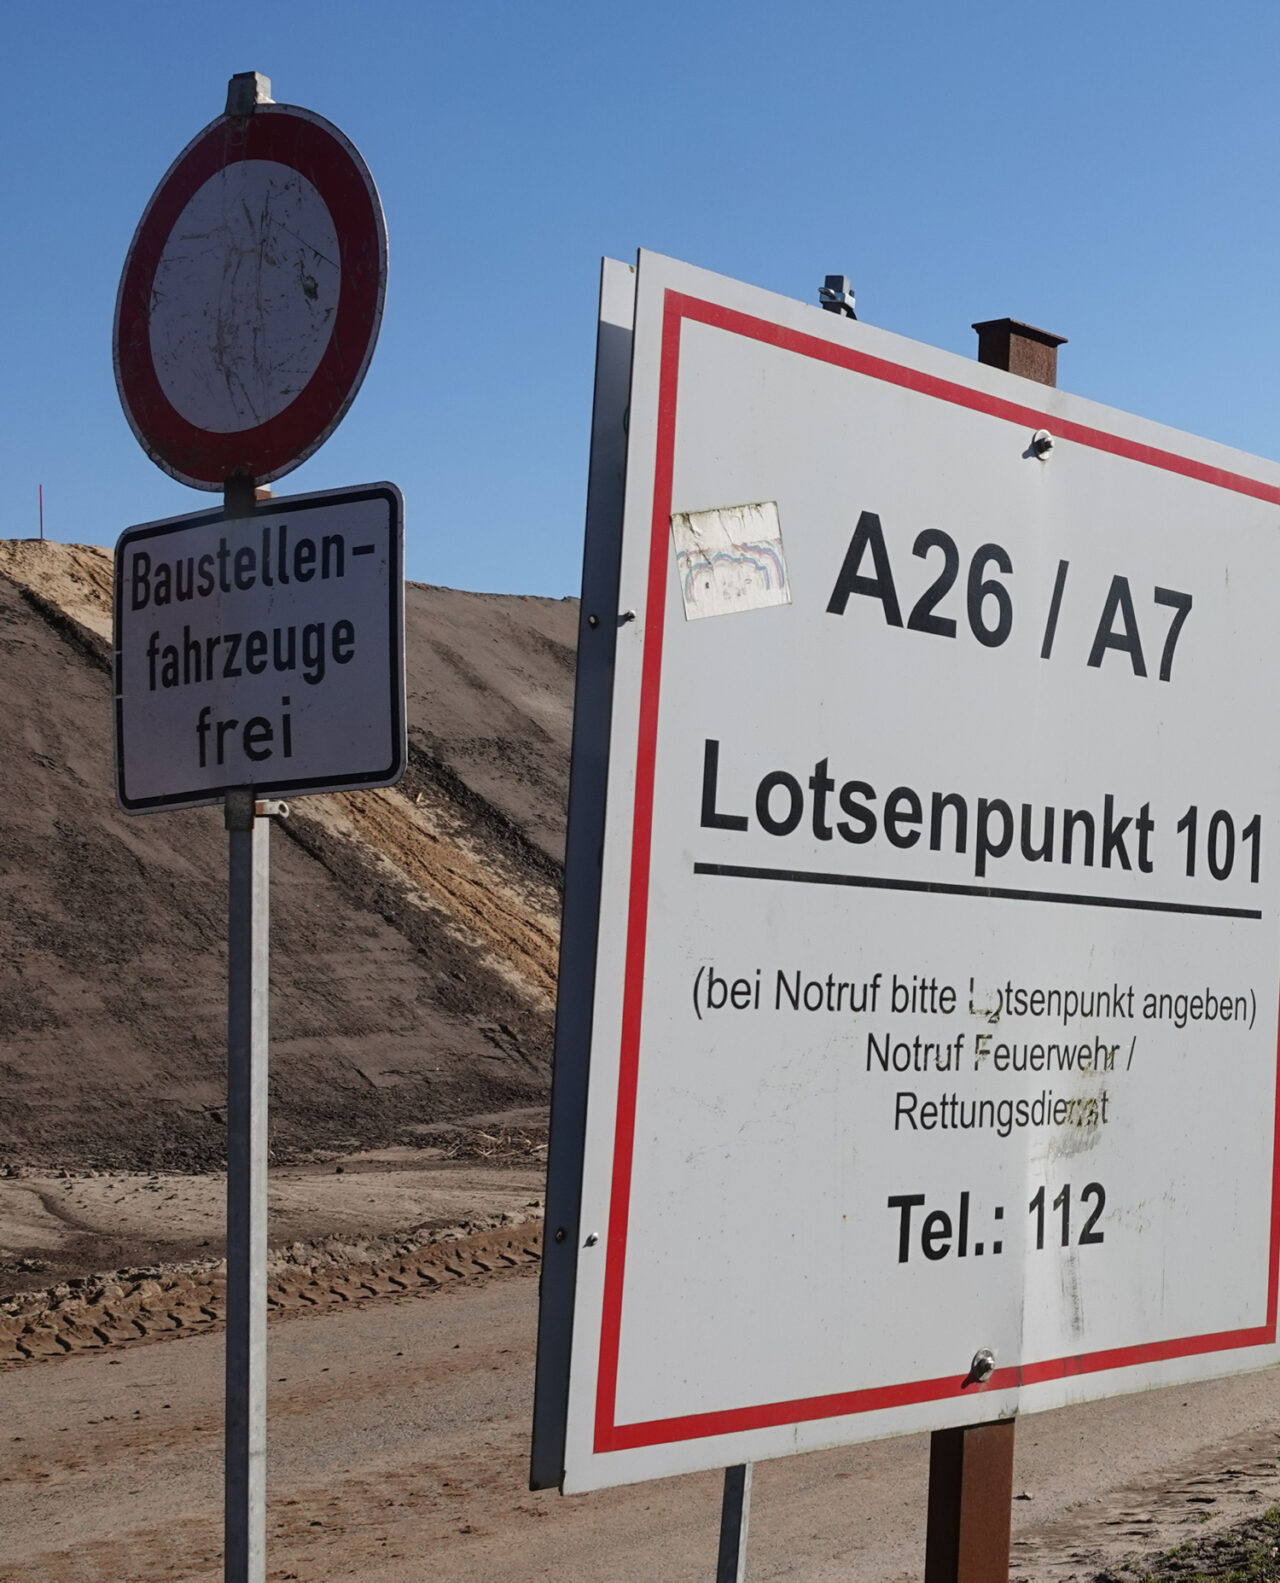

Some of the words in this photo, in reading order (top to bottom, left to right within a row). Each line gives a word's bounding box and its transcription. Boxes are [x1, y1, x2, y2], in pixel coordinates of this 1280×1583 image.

[131, 525, 376, 612] Baustellen-
[825, 510, 1013, 648] A26
[1040, 559, 1070, 660] /
[1086, 574, 1193, 683] A7
[146, 616, 356, 692] fahrzeuge
[195, 696, 294, 769] frei
[700, 739, 1155, 878] Lotsenpunkt
[1176, 806, 1262, 884] 101
[693, 965, 761, 1020] (bei
[775, 969, 883, 1013] Notruf
[891, 974, 957, 1015] bitte
[1142, 987, 1257, 1030] angeben)
[866, 1032, 965, 1072] Notruf
[974, 1033, 1120, 1072] Feuerwehr
[1126, 1035, 1137, 1071] /
[887, 1191, 1004, 1264] Tel.:
[1029, 1182, 1106, 1250] 112
